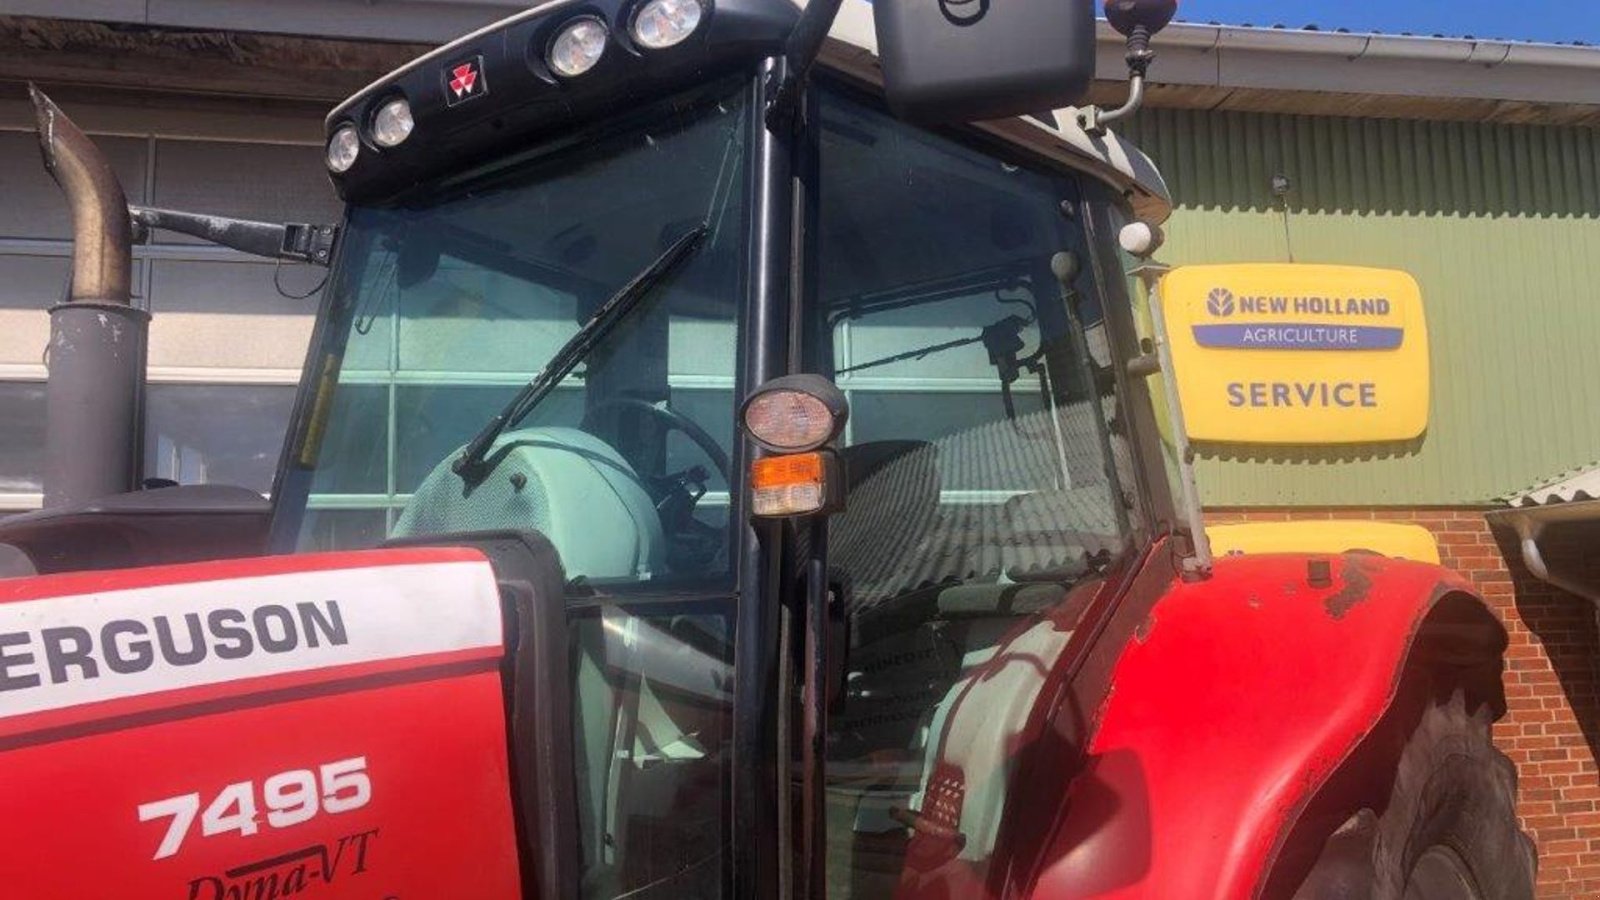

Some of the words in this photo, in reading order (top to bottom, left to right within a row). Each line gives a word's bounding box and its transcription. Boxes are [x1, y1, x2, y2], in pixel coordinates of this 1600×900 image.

[1239, 296, 1287, 315] NEW
[1293, 296, 1390, 316] HOLLAND
[1242, 328, 1358, 344] AGRICULTURE
[1226, 381, 1378, 408] SERVICE
[0, 600, 349, 692] ERGUSON
[138, 756, 373, 861] 7495
